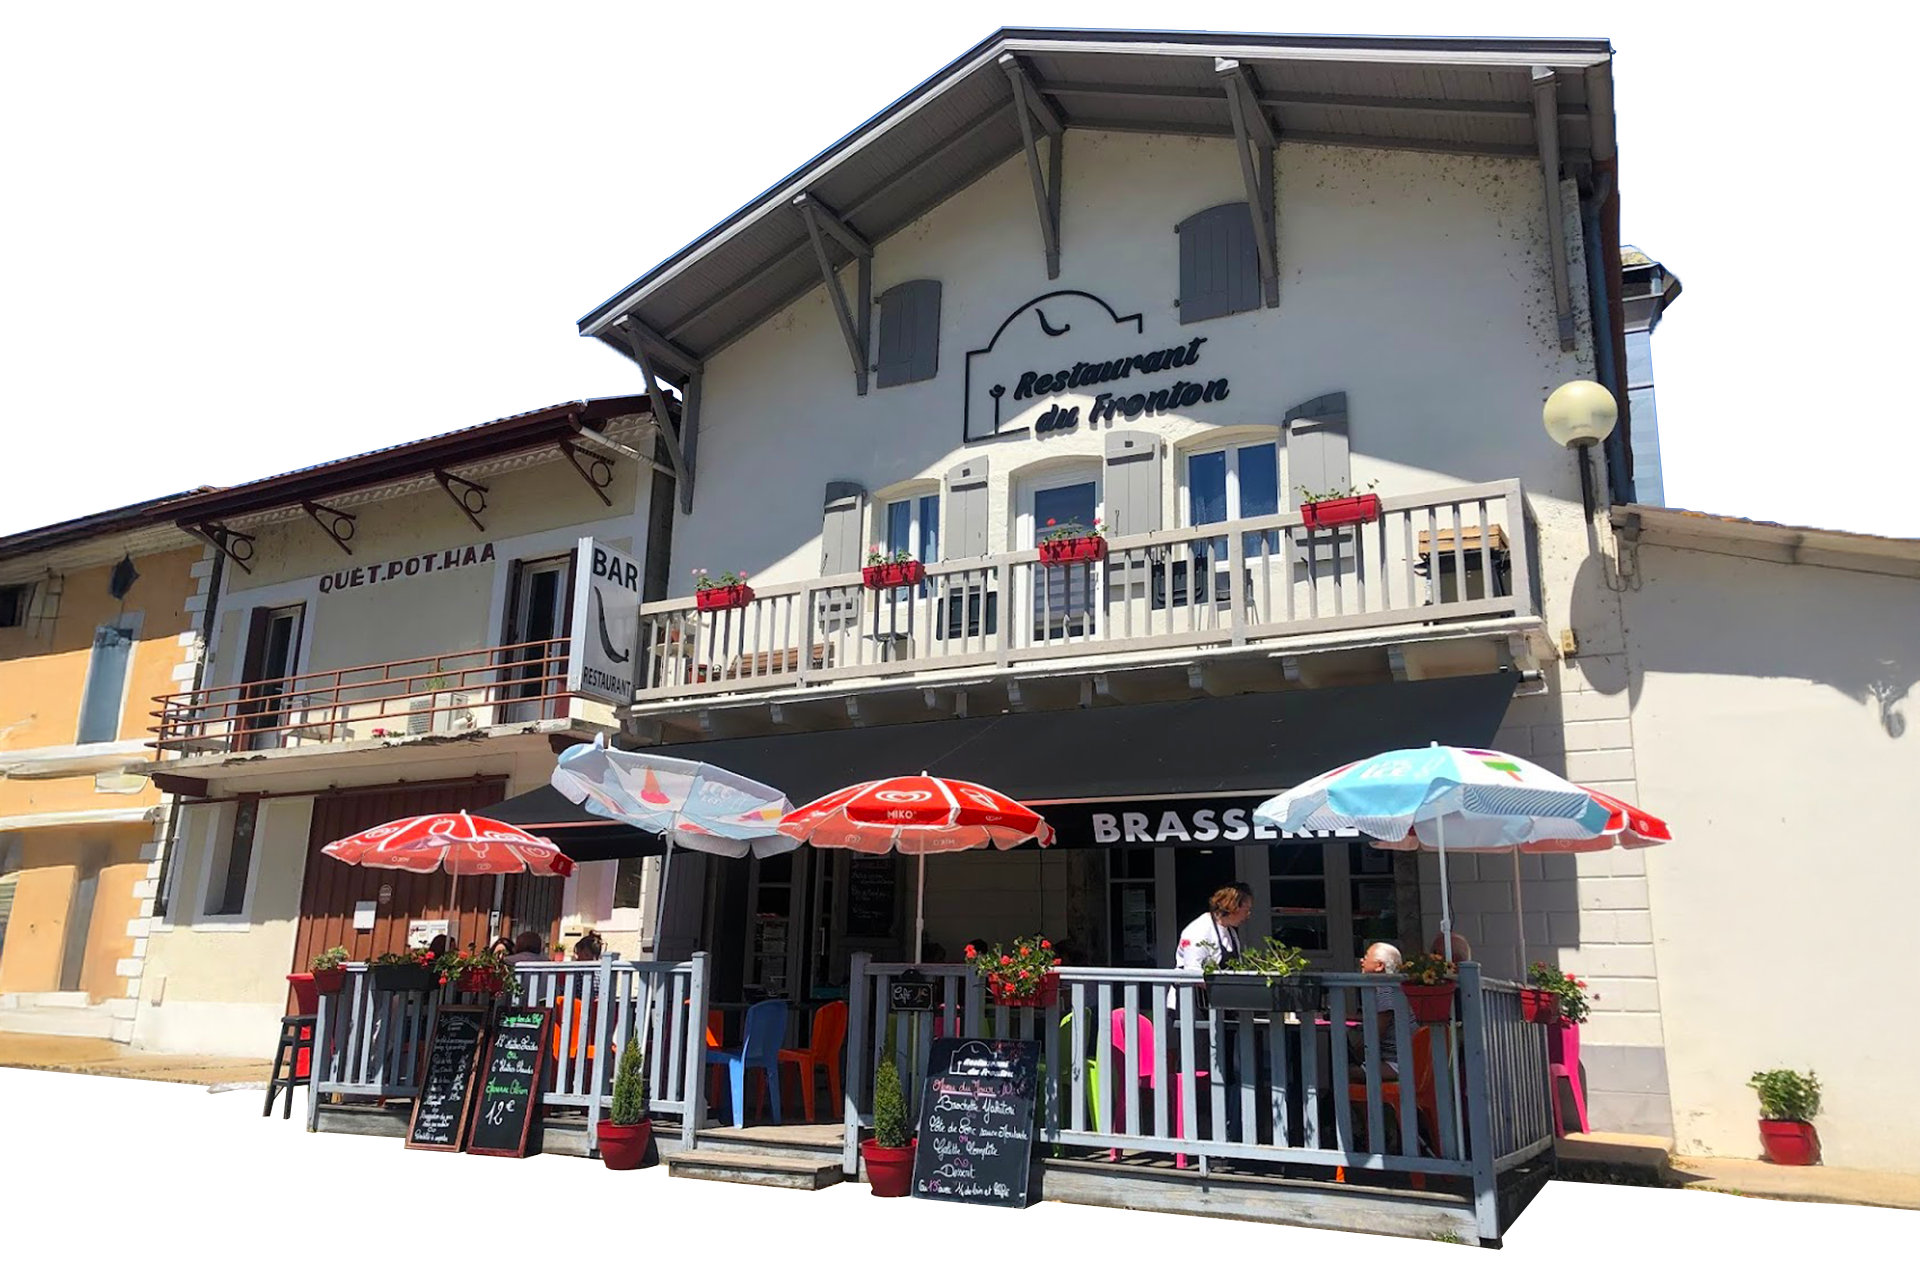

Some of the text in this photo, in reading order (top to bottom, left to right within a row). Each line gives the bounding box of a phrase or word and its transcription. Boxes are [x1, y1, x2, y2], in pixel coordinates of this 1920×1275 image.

[1014, 337, 1208, 400] Restaurant
[1035, 377, 1230, 433] du Fronton
[592, 547, 638, 592] BAR
[584, 666, 631, 697] RESTAURANT
[887, 810, 914, 819] MIKO
[959, 1081, 971, 1092] du
